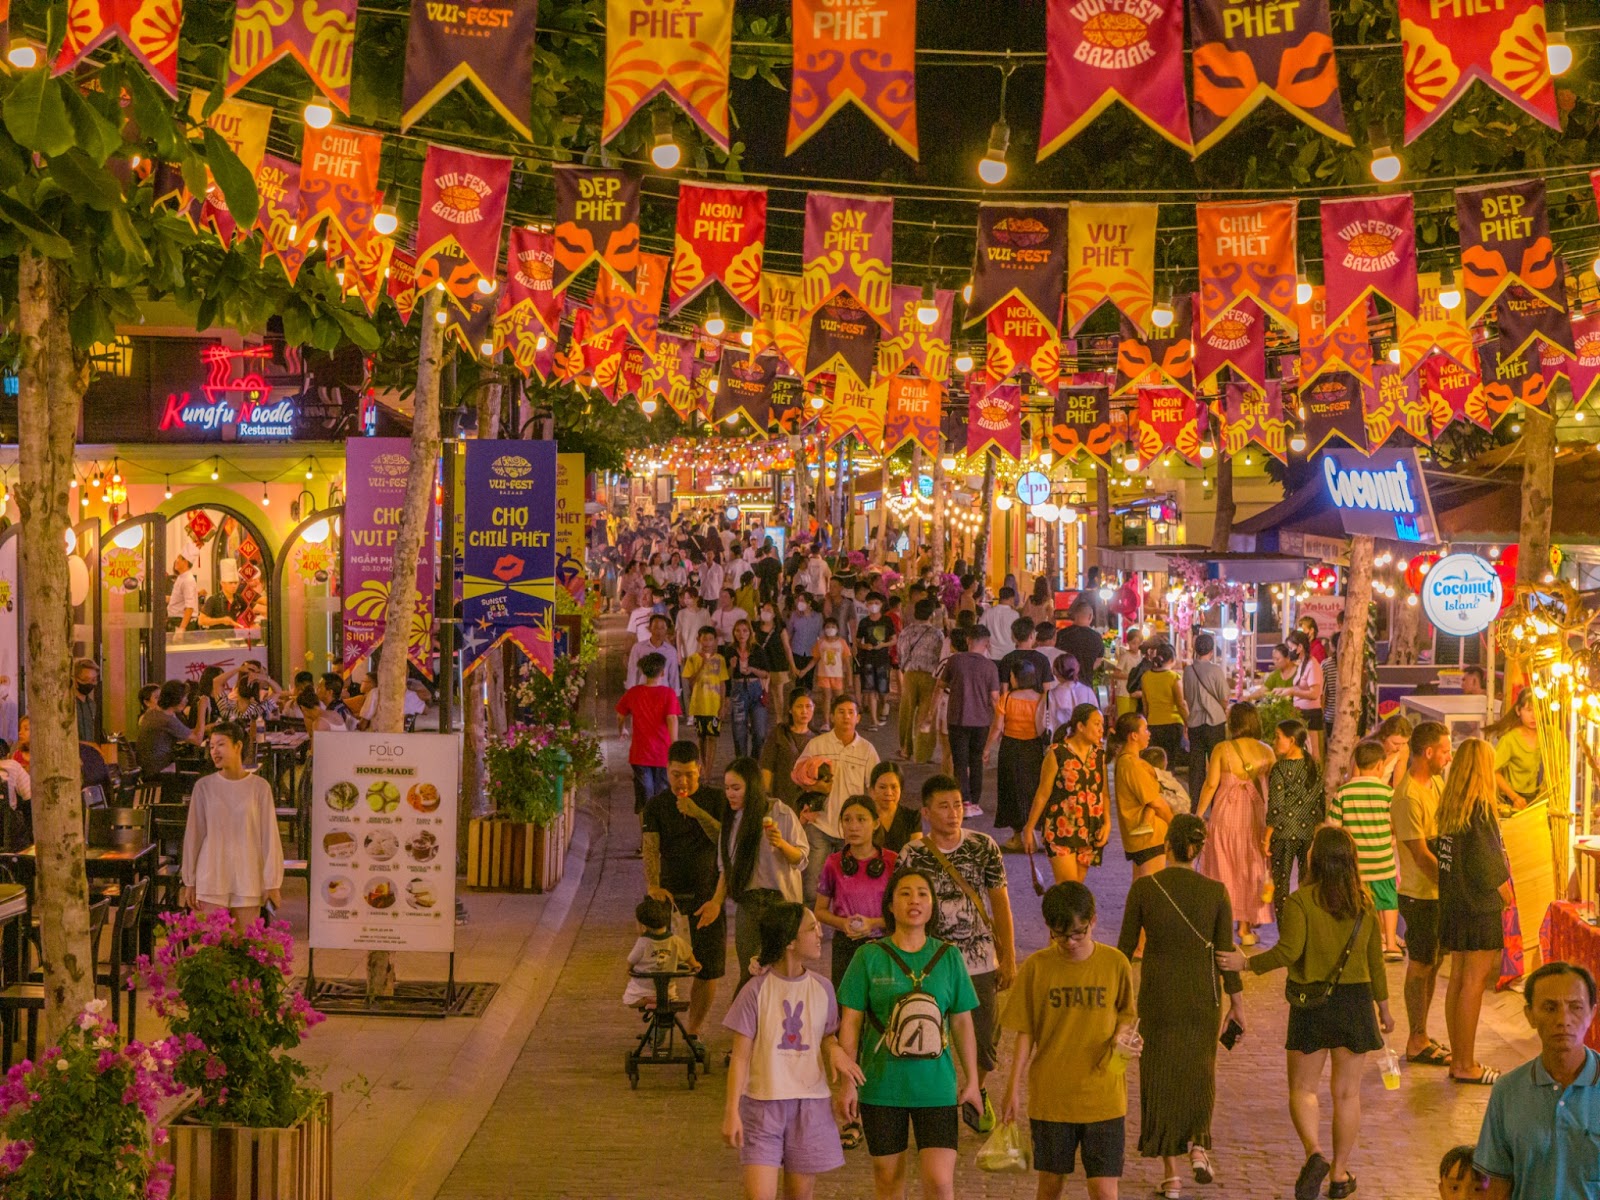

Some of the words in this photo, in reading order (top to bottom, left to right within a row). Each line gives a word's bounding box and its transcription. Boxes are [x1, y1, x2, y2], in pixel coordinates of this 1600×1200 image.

[426, 6, 514, 28] VUI-FEST
[629, 9, 703, 40] PHẾT
[813, 8, 889, 41] PHẾT
[1223, 2, 1300, 40] PHẾT
[1073, 40, 1157, 70] BAZAAR
[321, 135, 361, 156] CHILL
[261, 166, 289, 184] SAY
[313, 152, 362, 180] PHẾT
[434, 171, 493, 199] VUI-FEST
[579, 177, 621, 200] ĐẸP
[431, 201, 483, 225] BAZAAR
[575, 198, 626, 222] PHẾT
[700, 202, 743, 219] NGON
[1481, 195, 1527, 220] ĐẸP
[694, 218, 745, 244] PHẾT
[831, 209, 868, 233] SAY
[1219, 212, 1268, 235] CHILL
[1337, 219, 1404, 241] VUI-FEST
[1479, 217, 1534, 242] PHẾT
[824, 228, 873, 252] PHẾT
[1087, 223, 1128, 245] VUI
[1216, 232, 1271, 257] PHẾT
[518, 249, 554, 266] VUI-FES
[987, 247, 1052, 264] VUI-FEST
[1082, 244, 1135, 268] PHẾT
[1342, 251, 1401, 273] BAZAAR
[768, 287, 796, 306] VUI
[659, 342, 681, 356] SAY
[1207, 334, 1251, 351] BAZAAR
[901, 385, 929, 397] CHILL
[1379, 385, 1409, 402] PHẾT
[159, 392, 233, 430] Kungfu
[237, 401, 294, 424] Noodle
[897, 396, 930, 413] PHẾT
[976, 397, 1015, 414] VUI-FEST
[1068, 395, 1096, 410] ĐẸP
[1153, 397, 1181, 407] NGON
[977, 417, 1012, 431] BAZAAR
[1066, 407, 1099, 423] PHẾT
[1151, 407, 1184, 422] PHẾT
[240, 424, 293, 436] Restaurant
[489, 479, 534, 490] VUI-FEST
[1324, 456, 1415, 514] Coconut
[492, 506, 529, 529] CHỢ
[351, 530, 383, 547] VUI
[469, 528, 508, 548] CHILL
[511, 529, 551, 548] PHẾT
[1393, 516, 1421, 541] Island
[109, 567, 130, 578] 40K
[303, 561, 321, 571] 40K
[1432, 579, 1493, 597] Coconut
[1304, 602, 1341, 611] Yakult
[356, 767, 414, 776] HOME-MADE
[1049, 986, 1107, 1009] STATE
